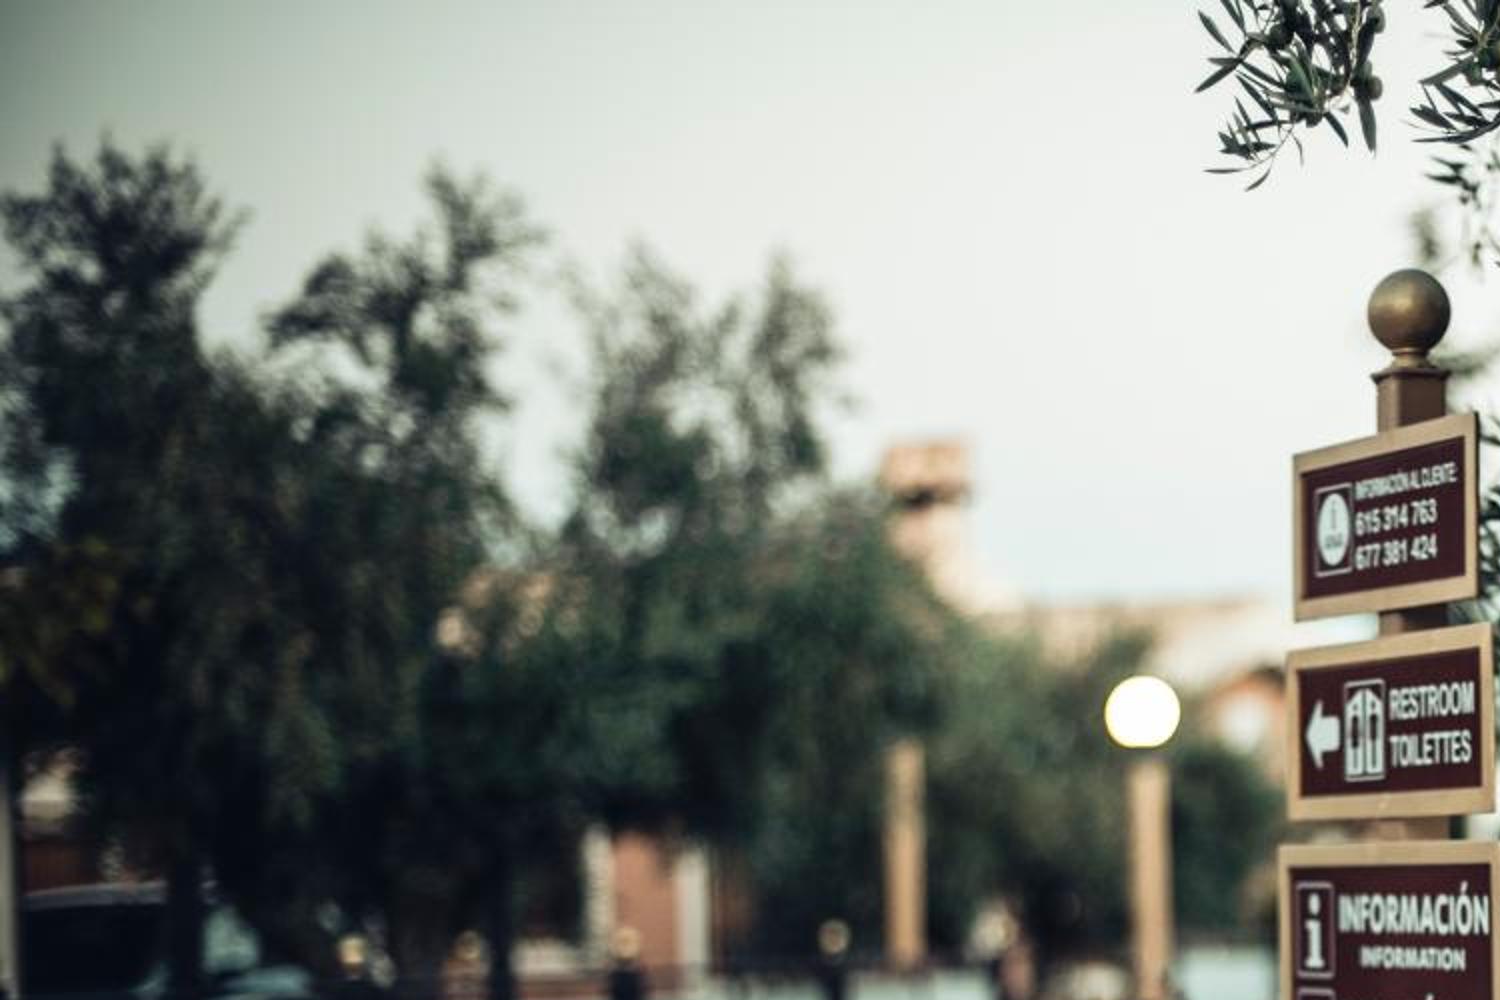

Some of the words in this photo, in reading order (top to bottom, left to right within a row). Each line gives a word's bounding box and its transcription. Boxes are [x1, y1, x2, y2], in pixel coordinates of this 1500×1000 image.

[1355, 508, 1381, 536] 615
[1383, 503, 1409, 531] 314
[1411, 498, 1438, 526] 763
[1355, 543, 1381, 571] 677
[1382, 539, 1408, 566] 381
[1410, 533, 1438, 561] 424
[1389, 680, 1476, 720] RESTROOM
[1389, 729, 1473, 768] TOILETTES
[1338, 880, 1490, 936] INFORMACIÓN
[1359, 946, 1467, 972] INFORMATION
